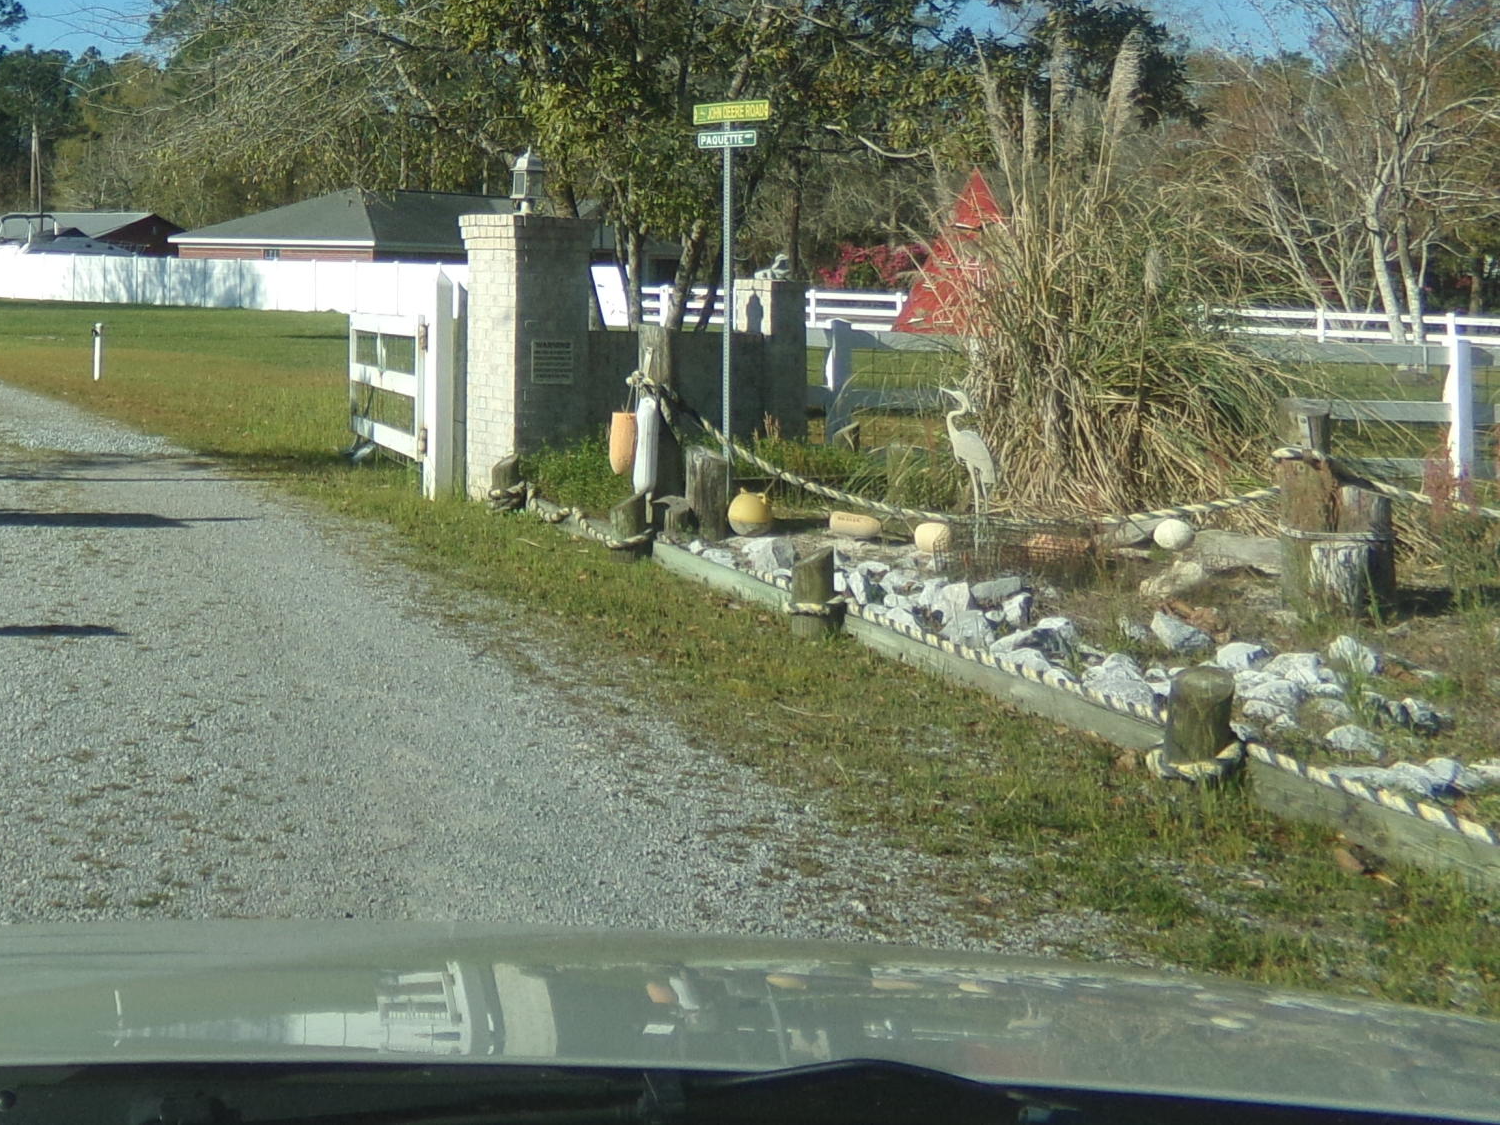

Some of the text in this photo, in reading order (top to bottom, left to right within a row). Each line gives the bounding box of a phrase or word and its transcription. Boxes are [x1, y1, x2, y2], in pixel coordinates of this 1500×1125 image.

[707, 103, 765, 120] JOHN DEERE ROAD
[700, 134, 744, 145] PAQUETTE
